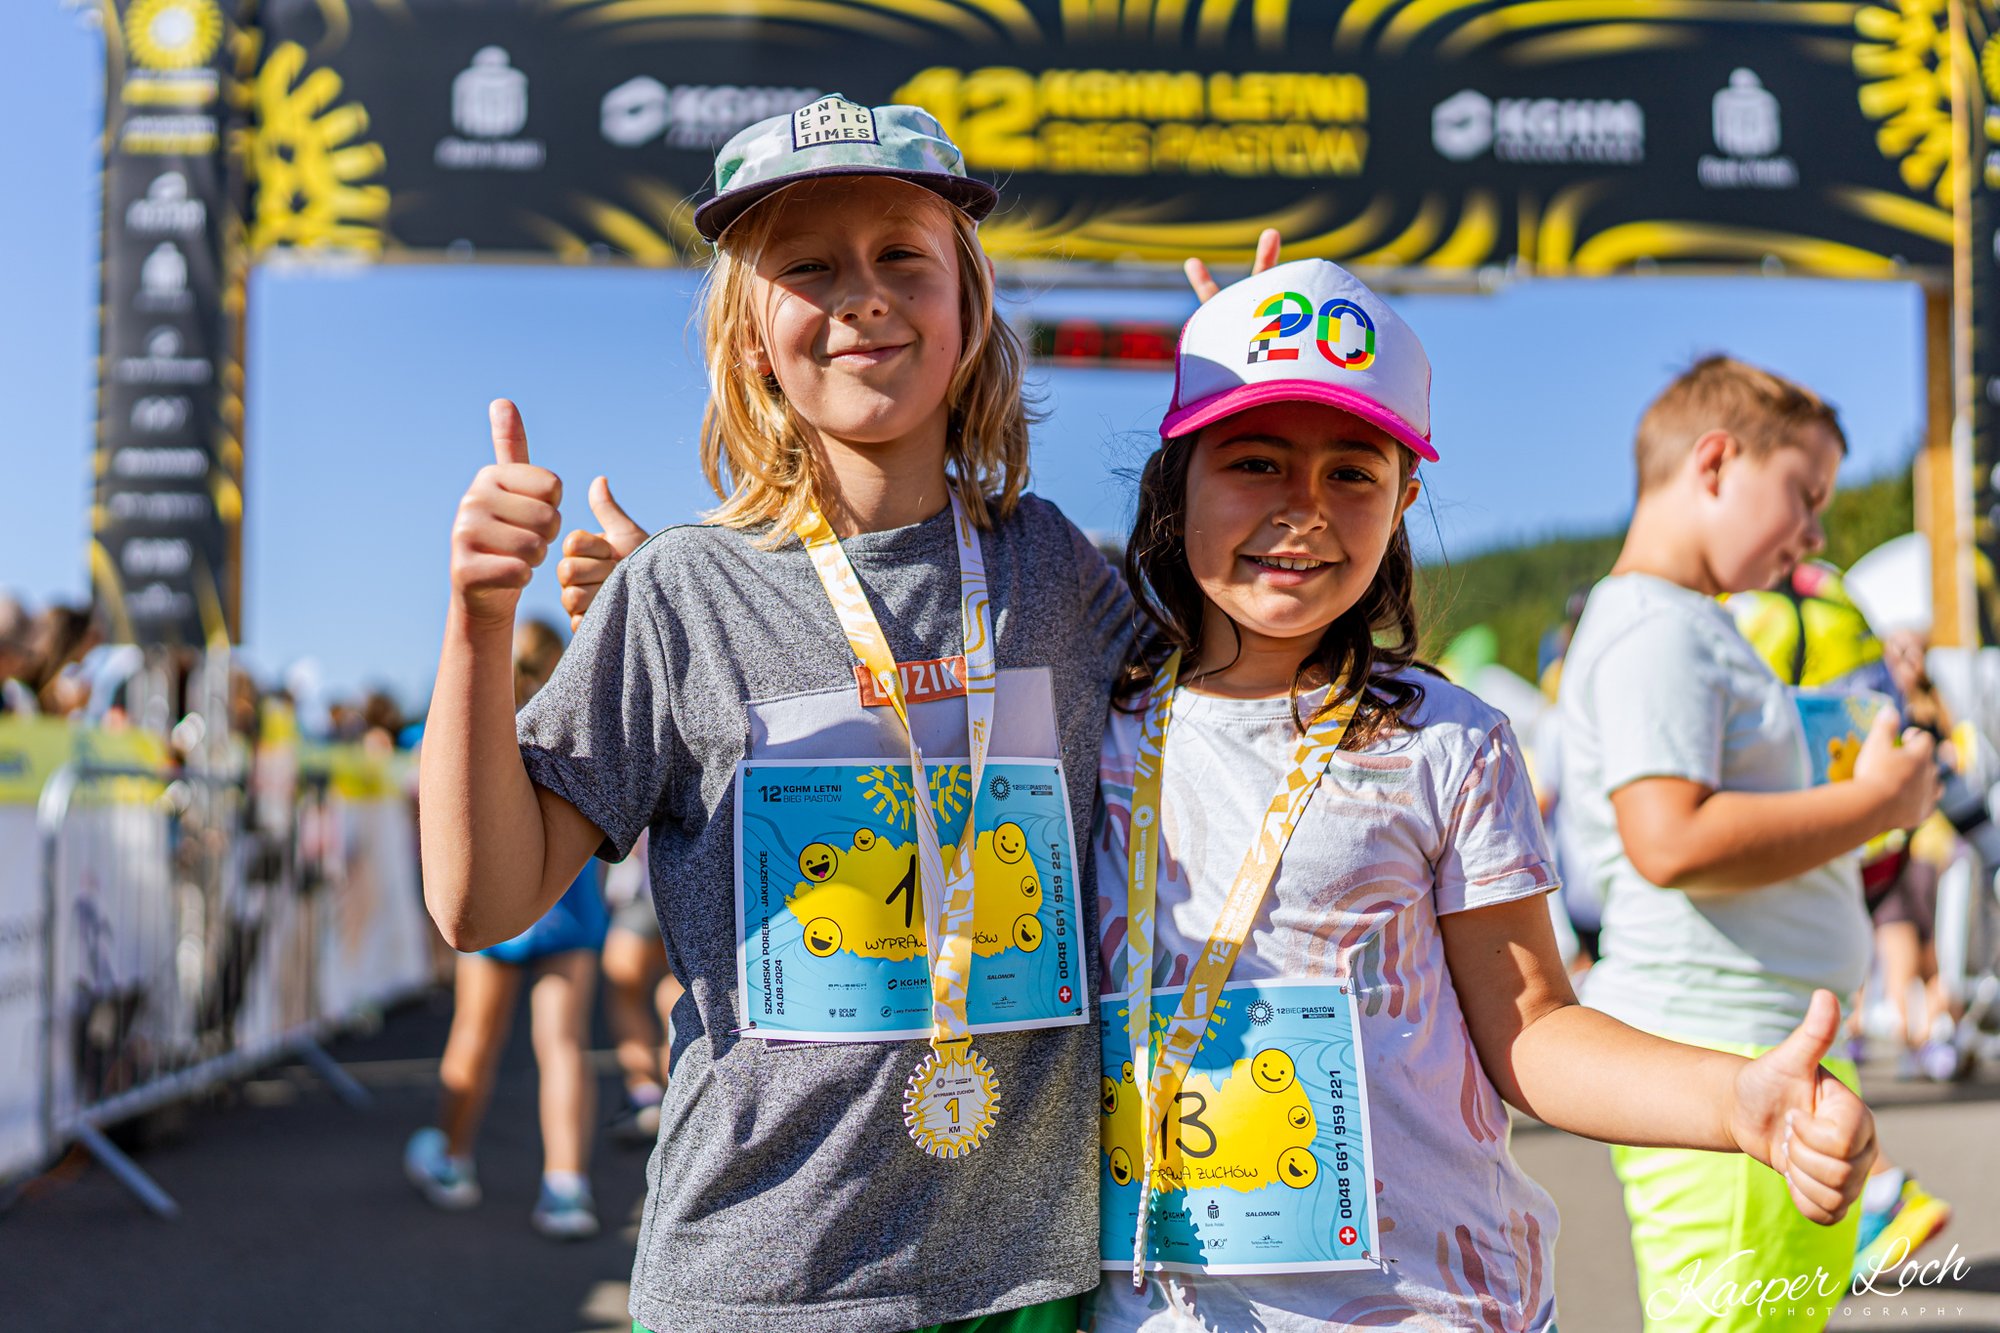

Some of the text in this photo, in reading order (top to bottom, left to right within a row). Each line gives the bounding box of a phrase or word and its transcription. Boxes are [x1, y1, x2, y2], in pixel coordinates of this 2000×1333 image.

[800, 113, 868, 130] EPIC
[801, 128, 871, 144] TIMES
[1247, 291, 1376, 372] 20
[758, 785, 782, 802] 12
[783, 784, 842, 793] KGHM LETNI
[783, 793, 842, 803] BIEG PIASTÓW
[760, 850, 769, 907] JAKUSZYCE
[1050, 843, 1069, 979] 0048 661 959 221
[761, 918, 771, 956] PORĘBA
[865, 934, 927, 951] WYPRAW
[1207, 939, 1233, 967] 12
[763, 959, 773, 1015] SZKLARSKA
[774, 959, 785, 1015] 24.08.2024
[900, 978, 928, 987] KGHM
[944, 1097, 960, 1124] 1
[948, 1125, 961, 1134] KM
[1329, 1070, 1353, 1219] 0048 661 959 221
